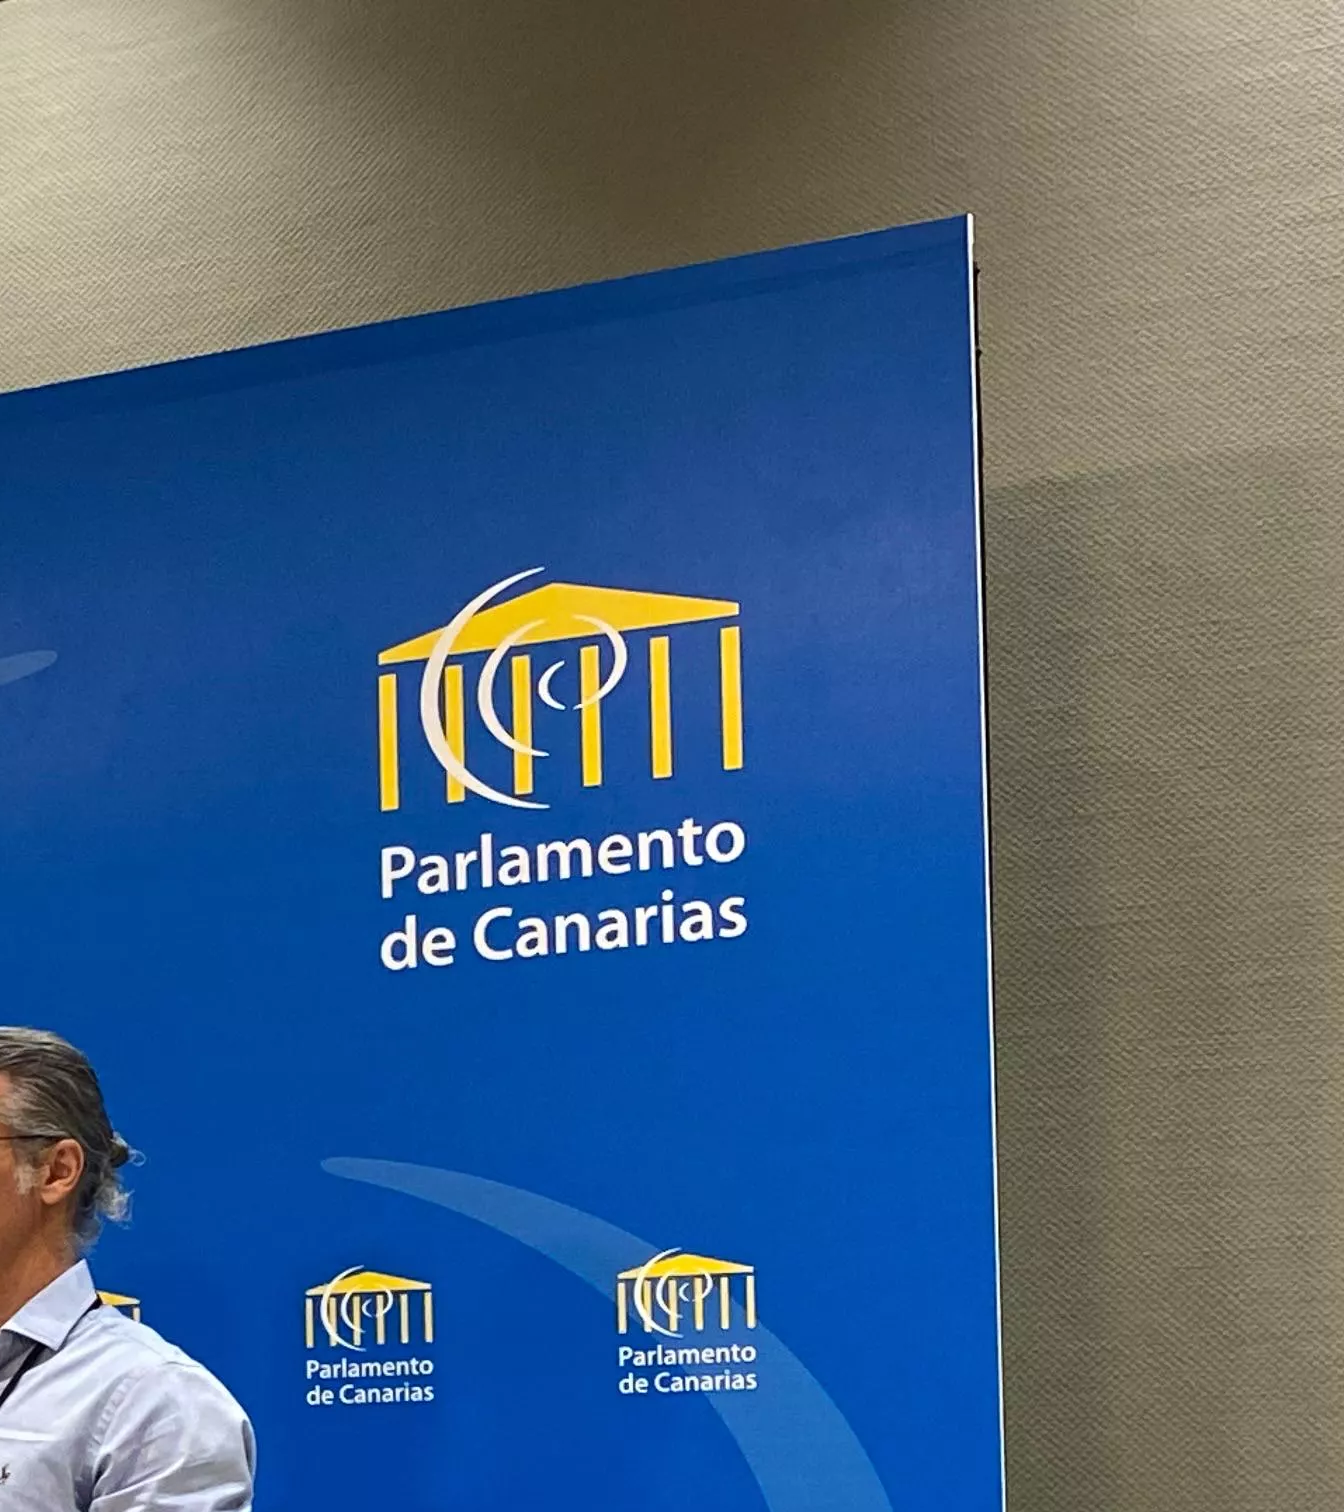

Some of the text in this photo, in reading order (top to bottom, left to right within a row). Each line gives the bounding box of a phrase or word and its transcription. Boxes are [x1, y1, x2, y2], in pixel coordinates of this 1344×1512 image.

[380, 817, 746, 899] Parlamento
[380, 889, 748, 971] de Canarias
[618, 1344, 757, 1367] Parlamento
[306, 1357, 434, 1380] Parlamento
[306, 1381, 435, 1406] de Canarias
[618, 1369, 758, 1394] de Canarias
